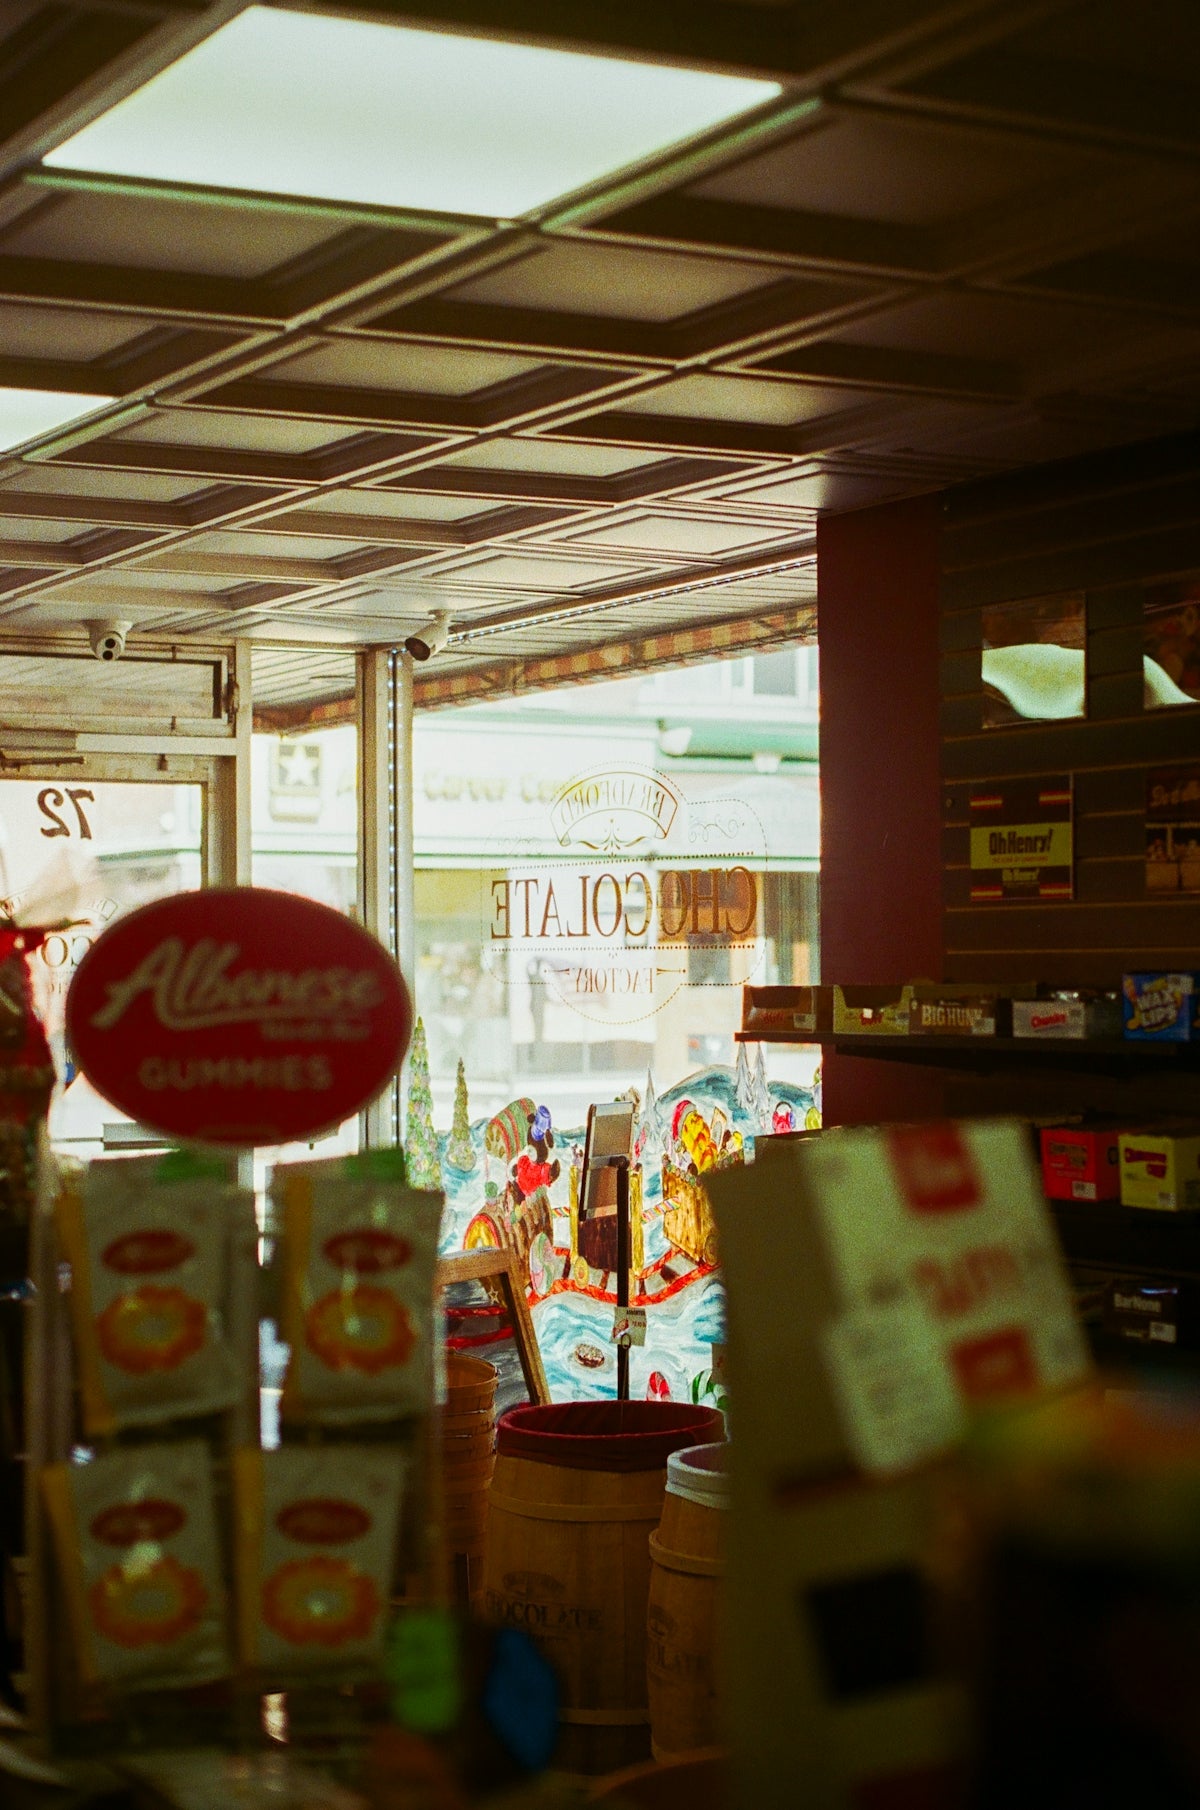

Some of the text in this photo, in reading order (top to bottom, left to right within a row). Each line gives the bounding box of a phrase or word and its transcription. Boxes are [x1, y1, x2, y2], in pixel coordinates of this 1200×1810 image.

[88, 935, 384, 1032] Albanese
[921, 1004, 945, 1026] BIG
[137, 1055, 334, 1093] GUMMIES
